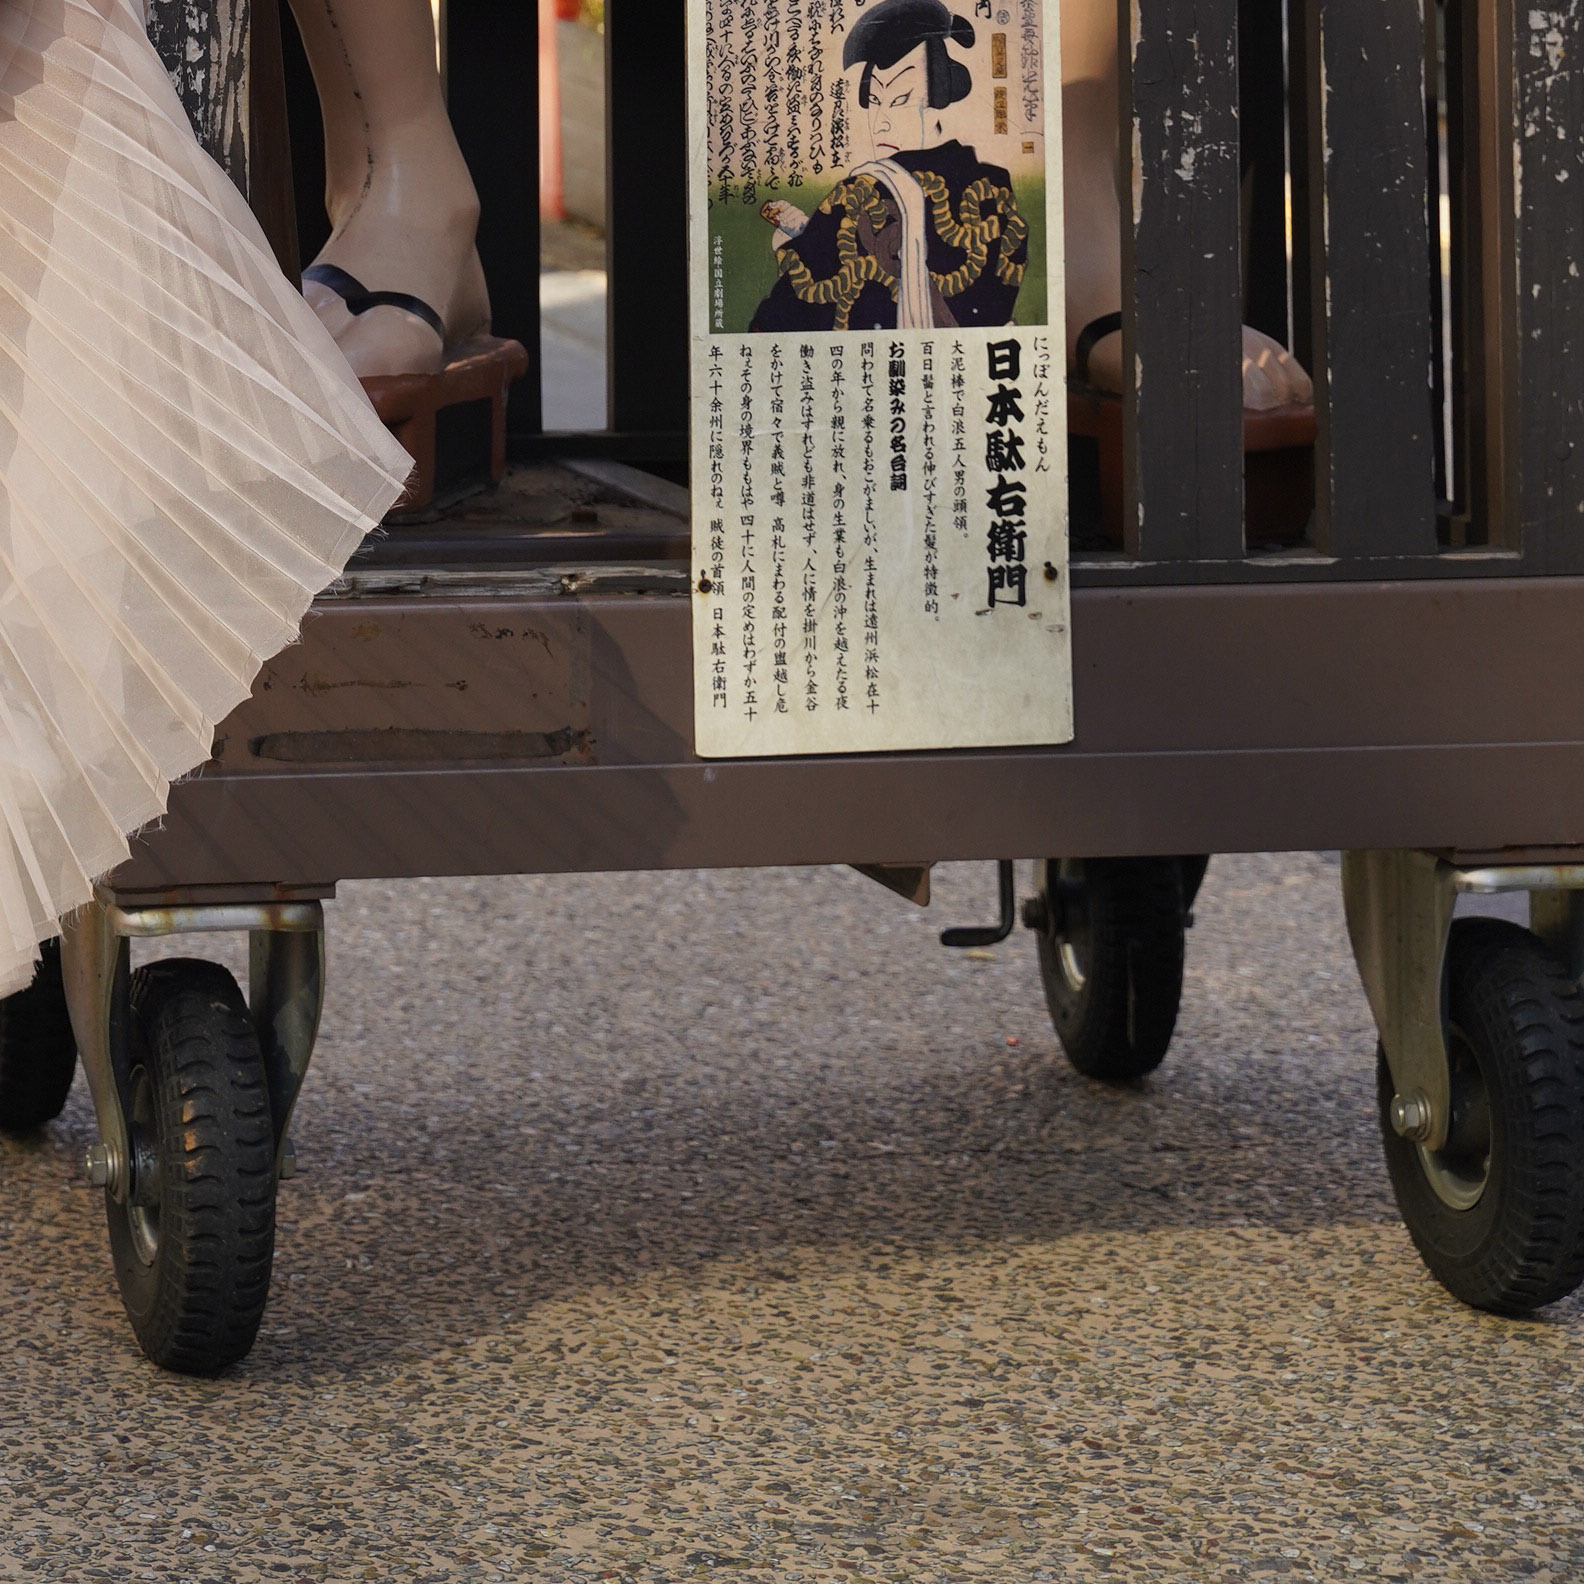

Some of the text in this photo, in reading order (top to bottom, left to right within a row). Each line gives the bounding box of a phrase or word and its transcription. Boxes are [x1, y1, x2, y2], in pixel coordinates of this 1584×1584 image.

[888, 341, 907, 491] お馴染みの名台詞
[951, 340, 968, 538] 大泥棒で白浪五人男の頭領。
[984, 339, 1028, 609] 日本駄右衛門
[1034, 337, 1050, 472] にっぽんだえもん
